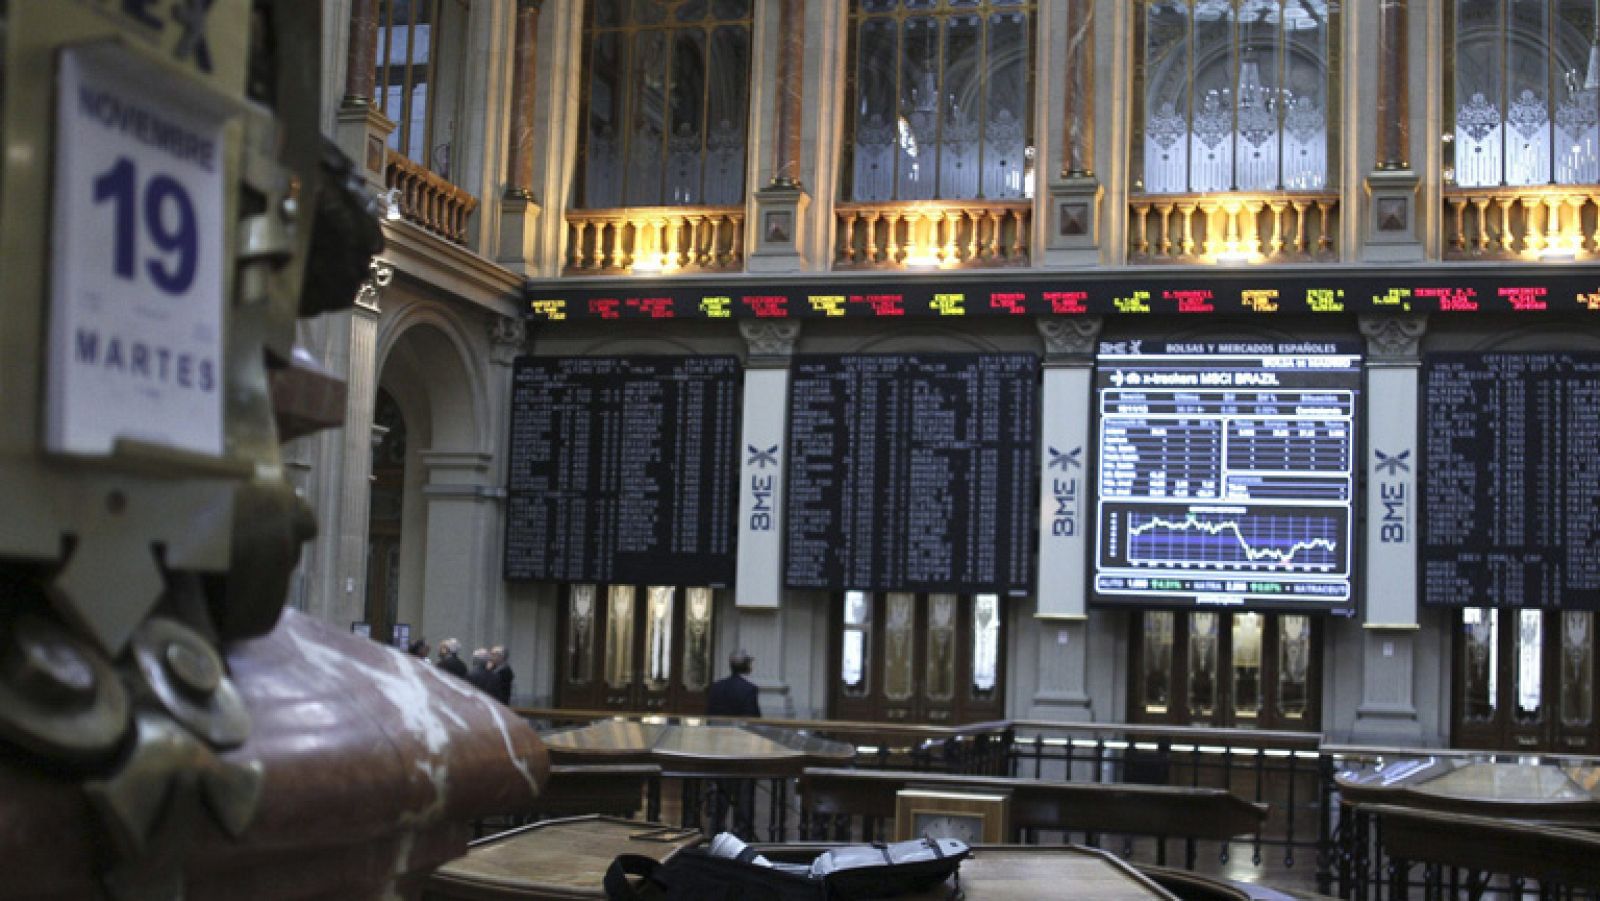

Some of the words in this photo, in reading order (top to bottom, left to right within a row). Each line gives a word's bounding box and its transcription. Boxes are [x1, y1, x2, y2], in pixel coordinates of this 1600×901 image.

[93, 156, 198, 294] 19
[75, 328, 215, 392] MARTES
[1166, 343, 1204, 353] BOLSAS
[1208, 343, 1215, 353] Y
[1219, 343, 1274, 353] MERCADOS
[1279, 341, 1336, 353] ESPAÑOLES
